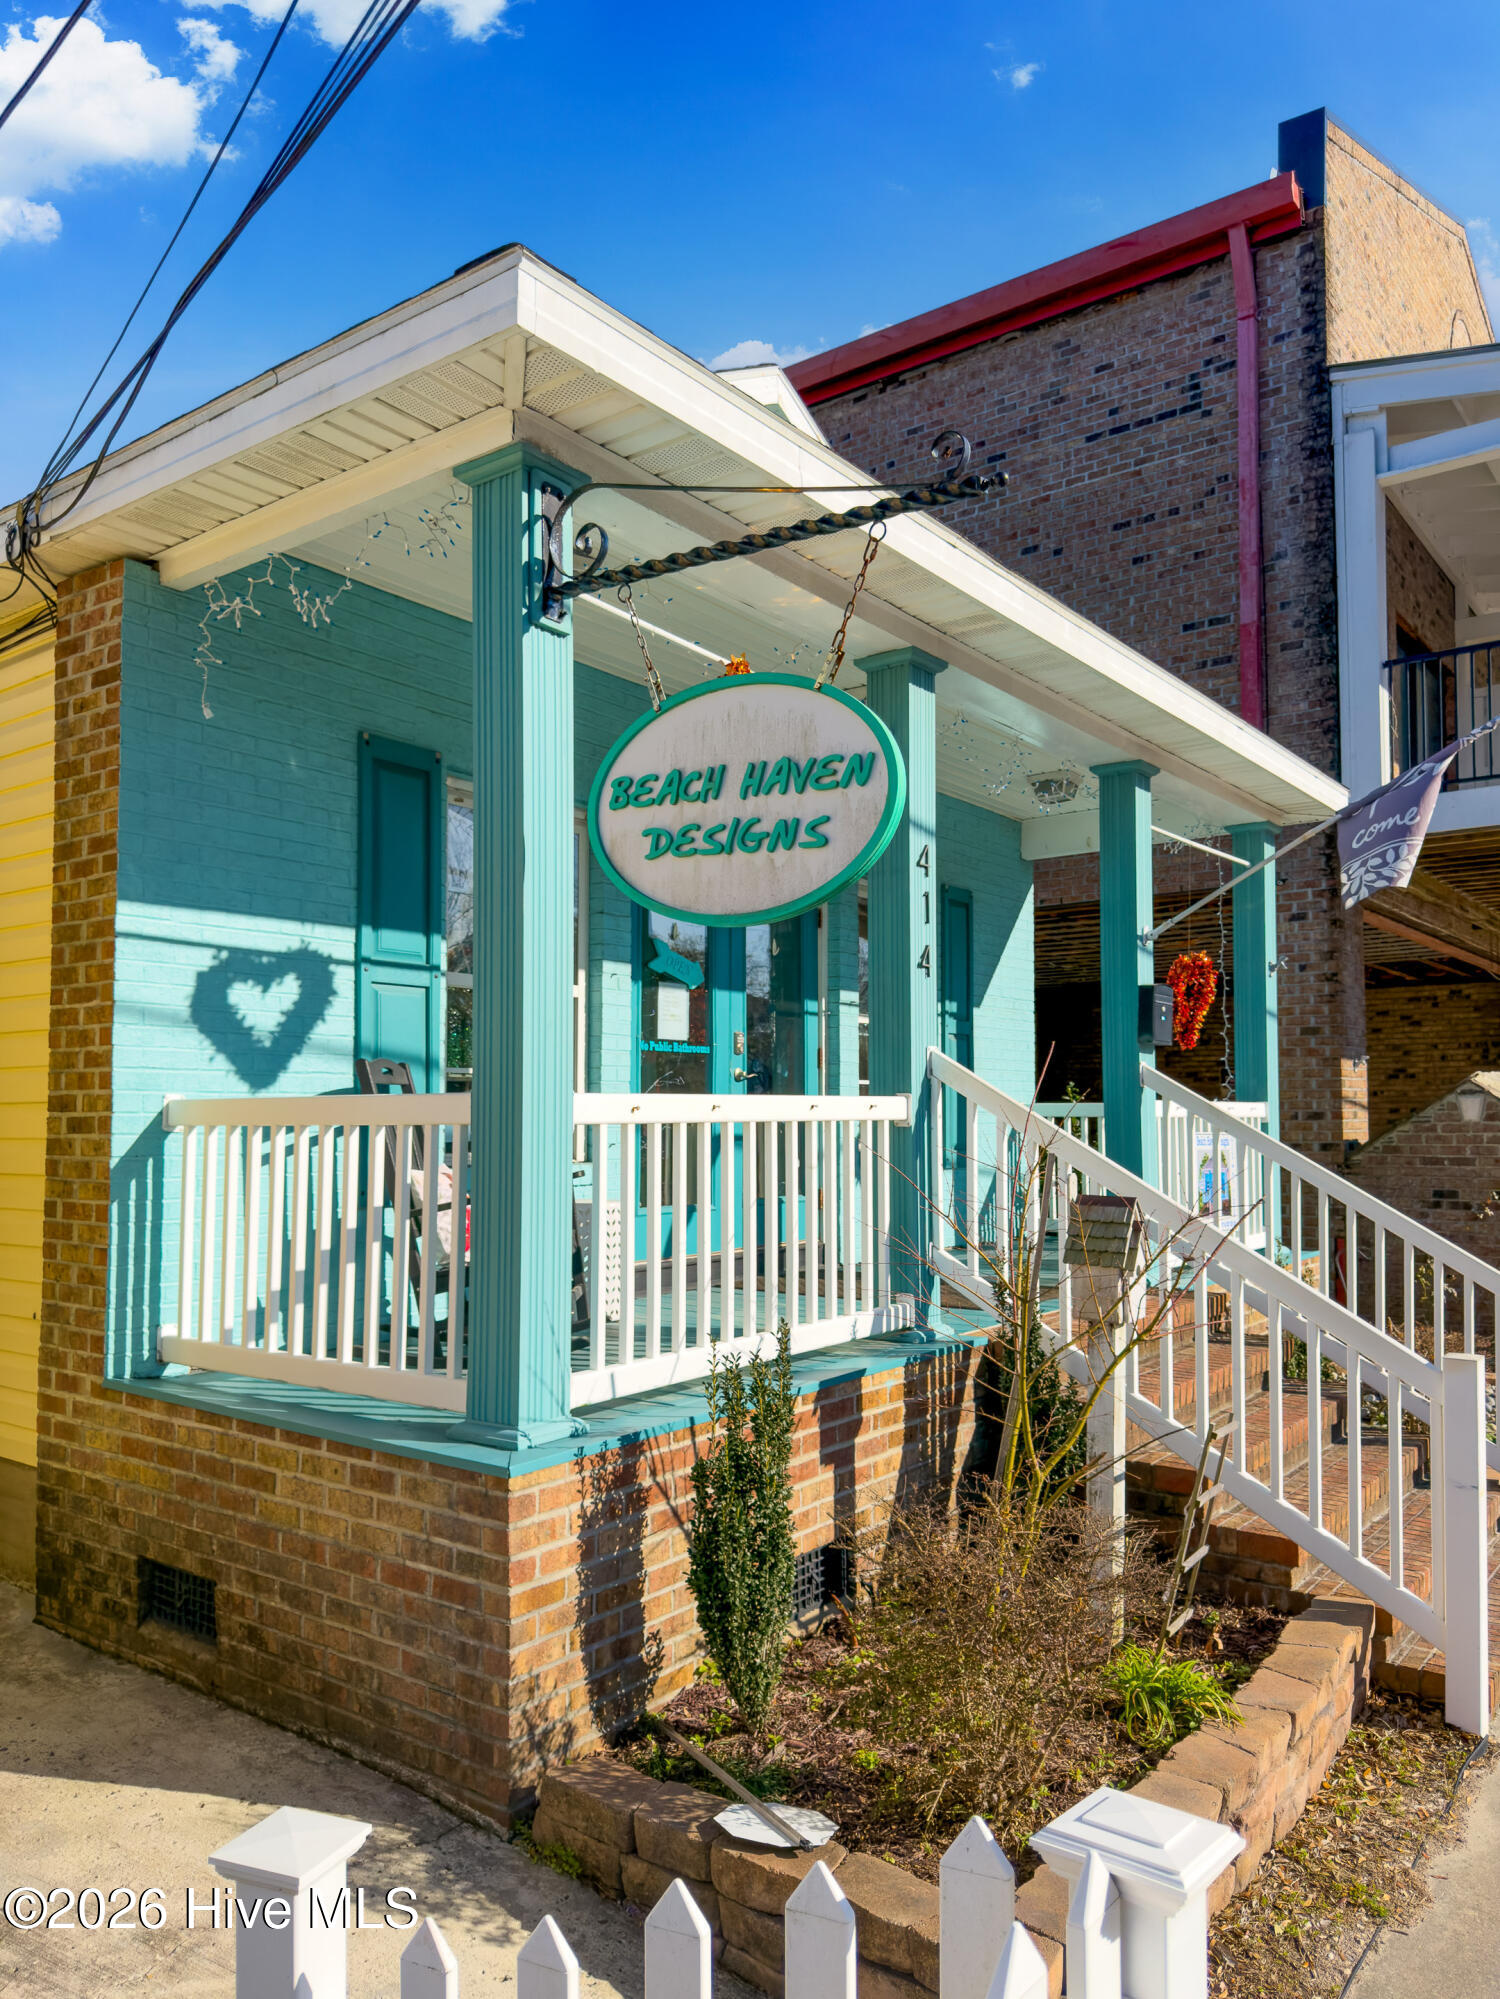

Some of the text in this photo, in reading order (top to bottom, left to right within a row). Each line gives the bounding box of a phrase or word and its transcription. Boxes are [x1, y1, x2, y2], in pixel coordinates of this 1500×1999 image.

[609, 752, 875, 811] BEACH HAVEN
[641, 815, 830, 861] DESIGNS
[1351, 807, 1420, 849] come
[649, 1040, 673, 1051] Public
[673, 1042, 710, 1053] Bathrooms
